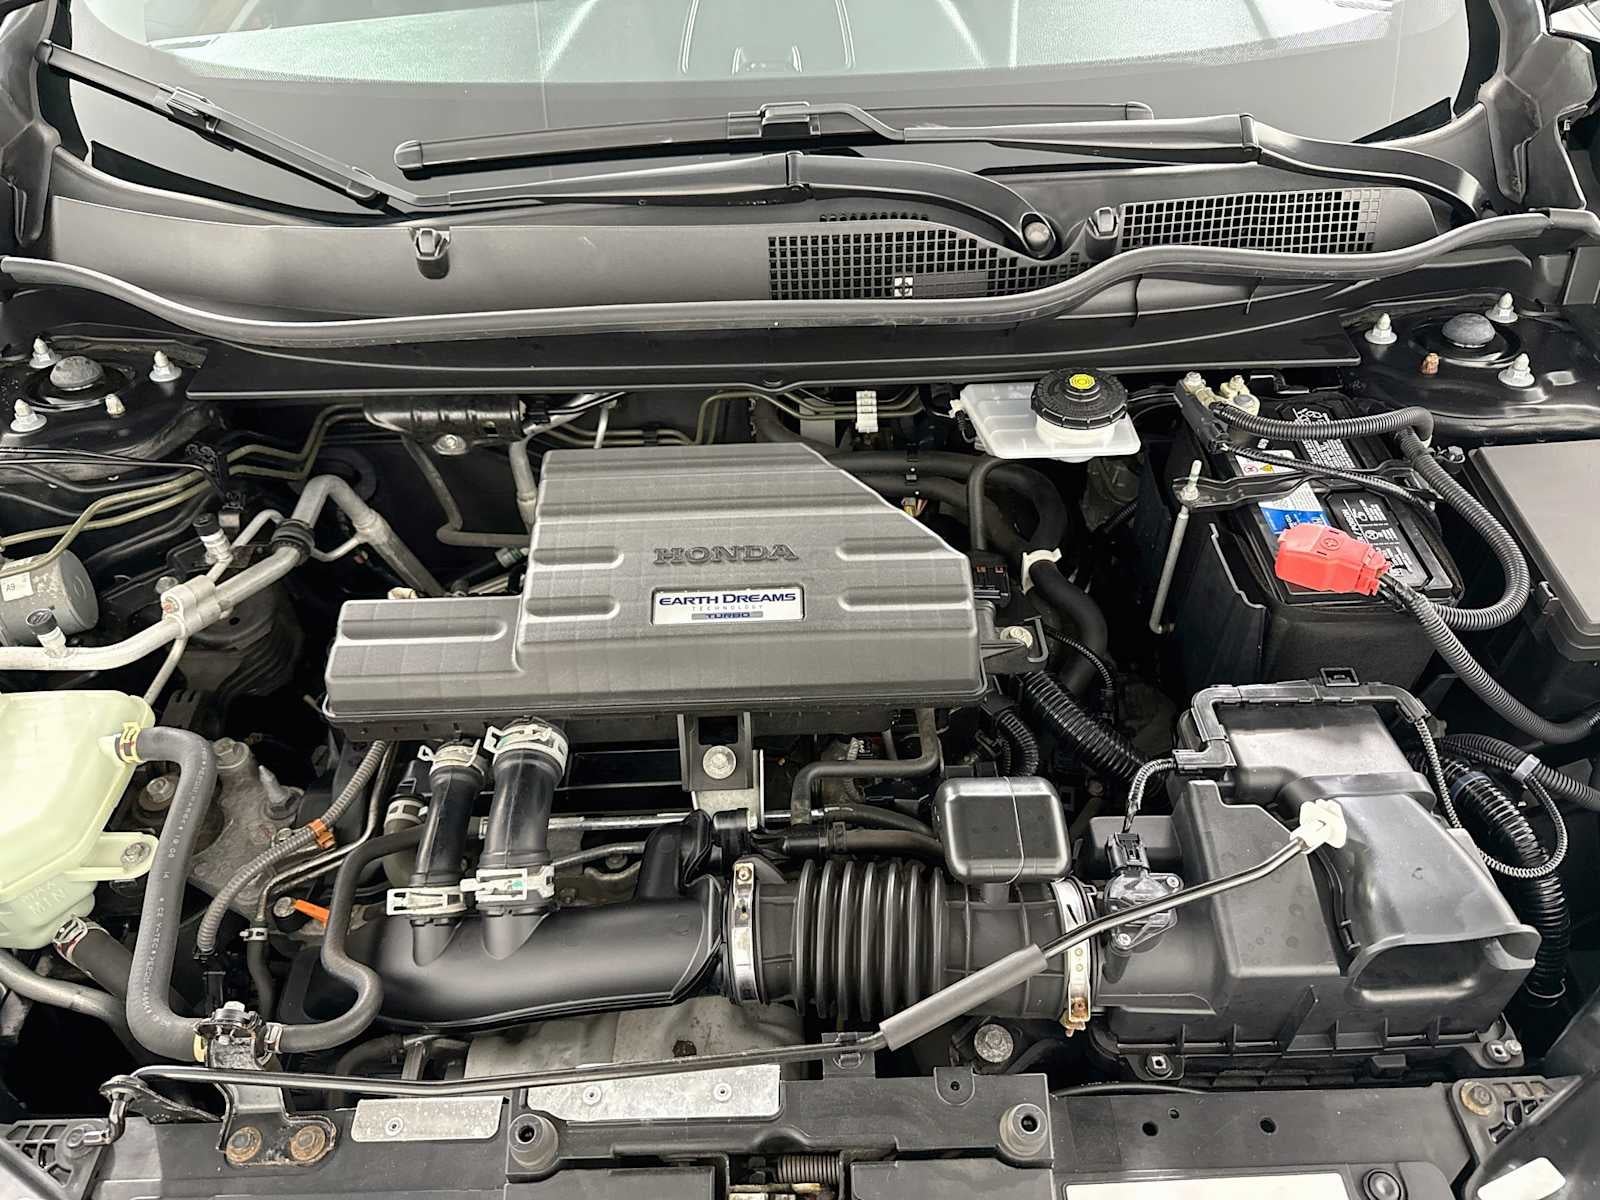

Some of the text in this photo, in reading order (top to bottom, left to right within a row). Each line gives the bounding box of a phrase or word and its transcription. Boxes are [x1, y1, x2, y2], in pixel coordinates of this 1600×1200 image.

[653, 543, 800, 565] HONDA
[659, 592, 797, 606] EARTH DREAMS
[704, 611, 751, 620] TURBO
